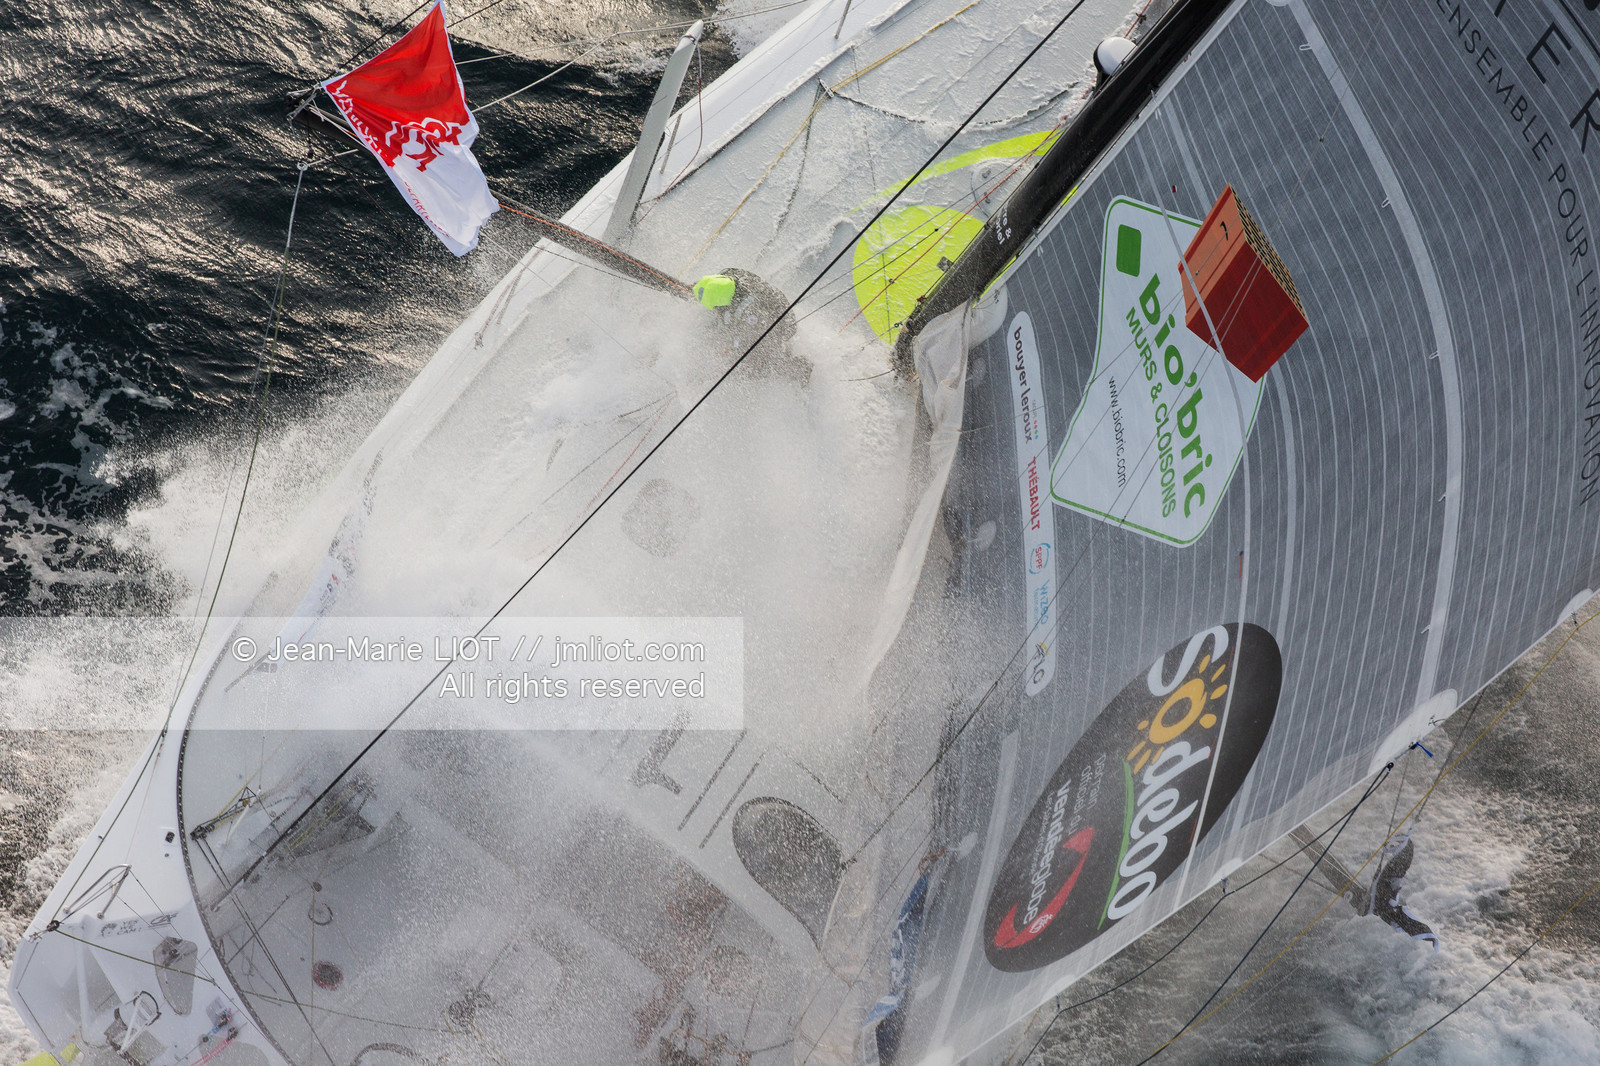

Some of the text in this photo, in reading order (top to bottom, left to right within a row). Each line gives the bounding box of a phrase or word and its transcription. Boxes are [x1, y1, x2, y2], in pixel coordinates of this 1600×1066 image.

[1437, 0, 1553, 162] ENSEMBLE
[1548, 163, 1588, 267] POUR
[1013, 326, 1033, 444] bouyer leroux
[1108, 376, 1127, 488] www.biobric.com
[1126, 306, 1177, 518] MURS & CLOISONS
[1026, 456, 1041, 531] THÉBAULT
[1107, 624, 1228, 920] Sodebo
